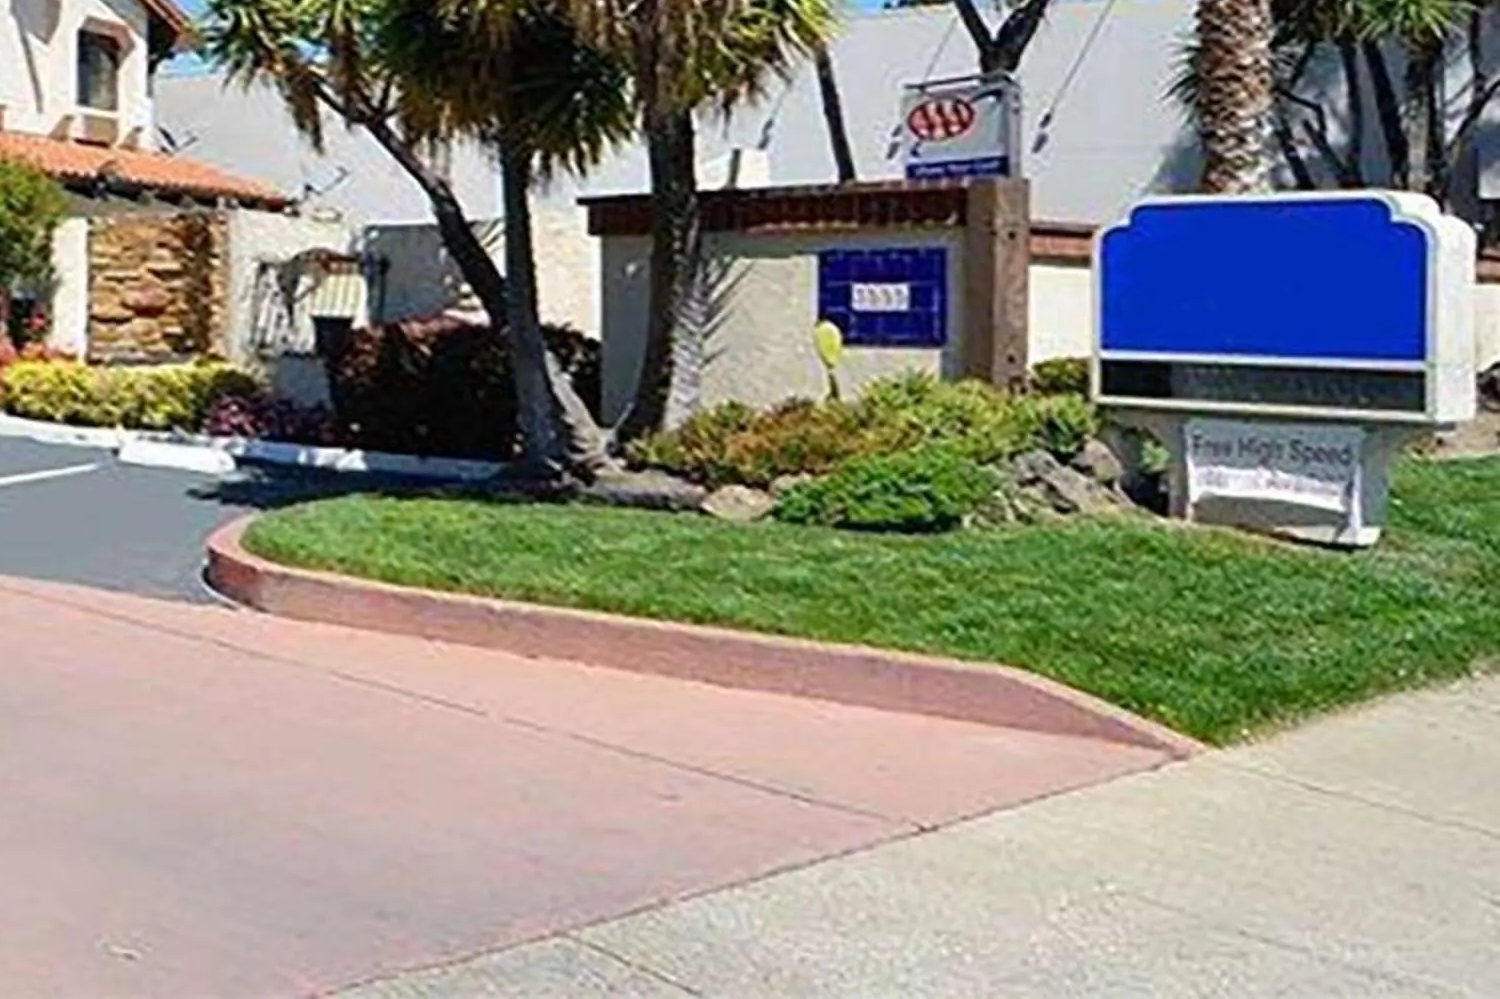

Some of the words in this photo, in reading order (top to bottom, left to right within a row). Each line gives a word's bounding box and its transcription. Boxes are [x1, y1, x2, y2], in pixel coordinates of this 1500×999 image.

[909, 99, 974, 140] AAA
[1192, 432, 1233, 457] Free
[1237, 436, 1284, 465] High
[1289, 438, 1353, 465] Speed
